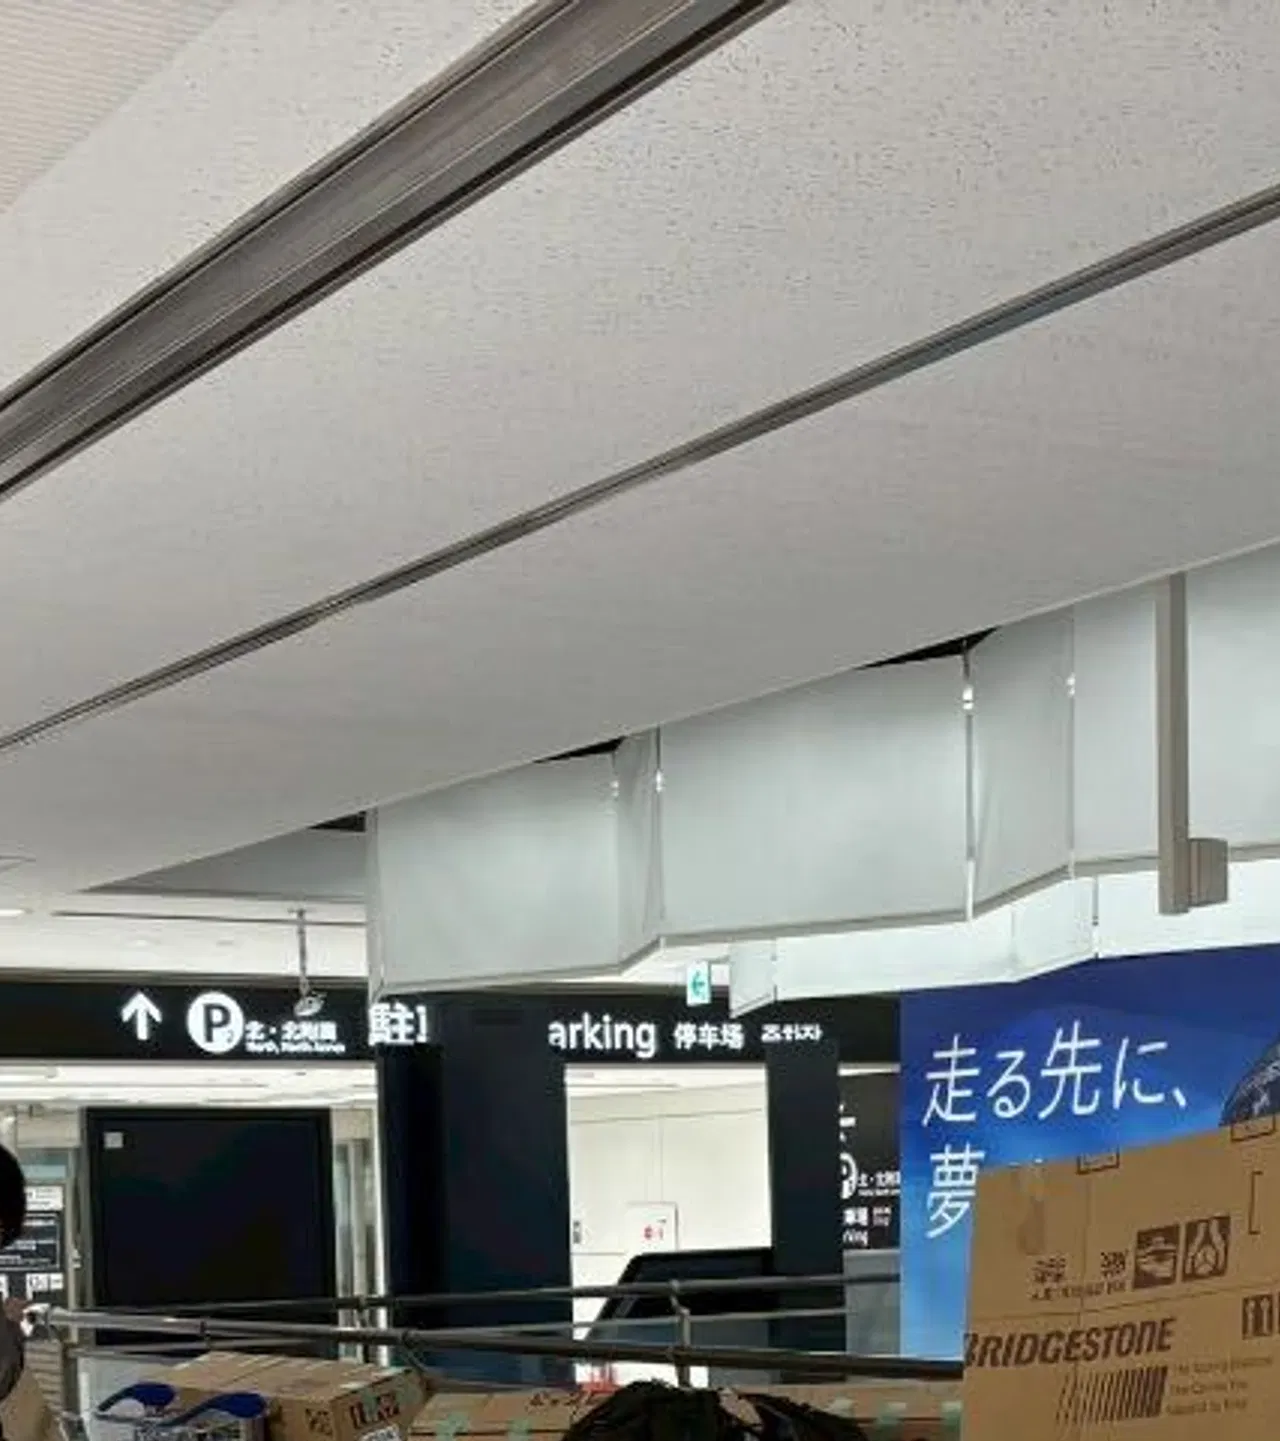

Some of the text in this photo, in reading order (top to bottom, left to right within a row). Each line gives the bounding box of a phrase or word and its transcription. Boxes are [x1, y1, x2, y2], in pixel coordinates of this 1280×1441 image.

[547, 1012, 656, 1059] arking
[673, 1021, 745, 1050] 停车场
[922, 1020, 1187, 1128] 走る先に、
